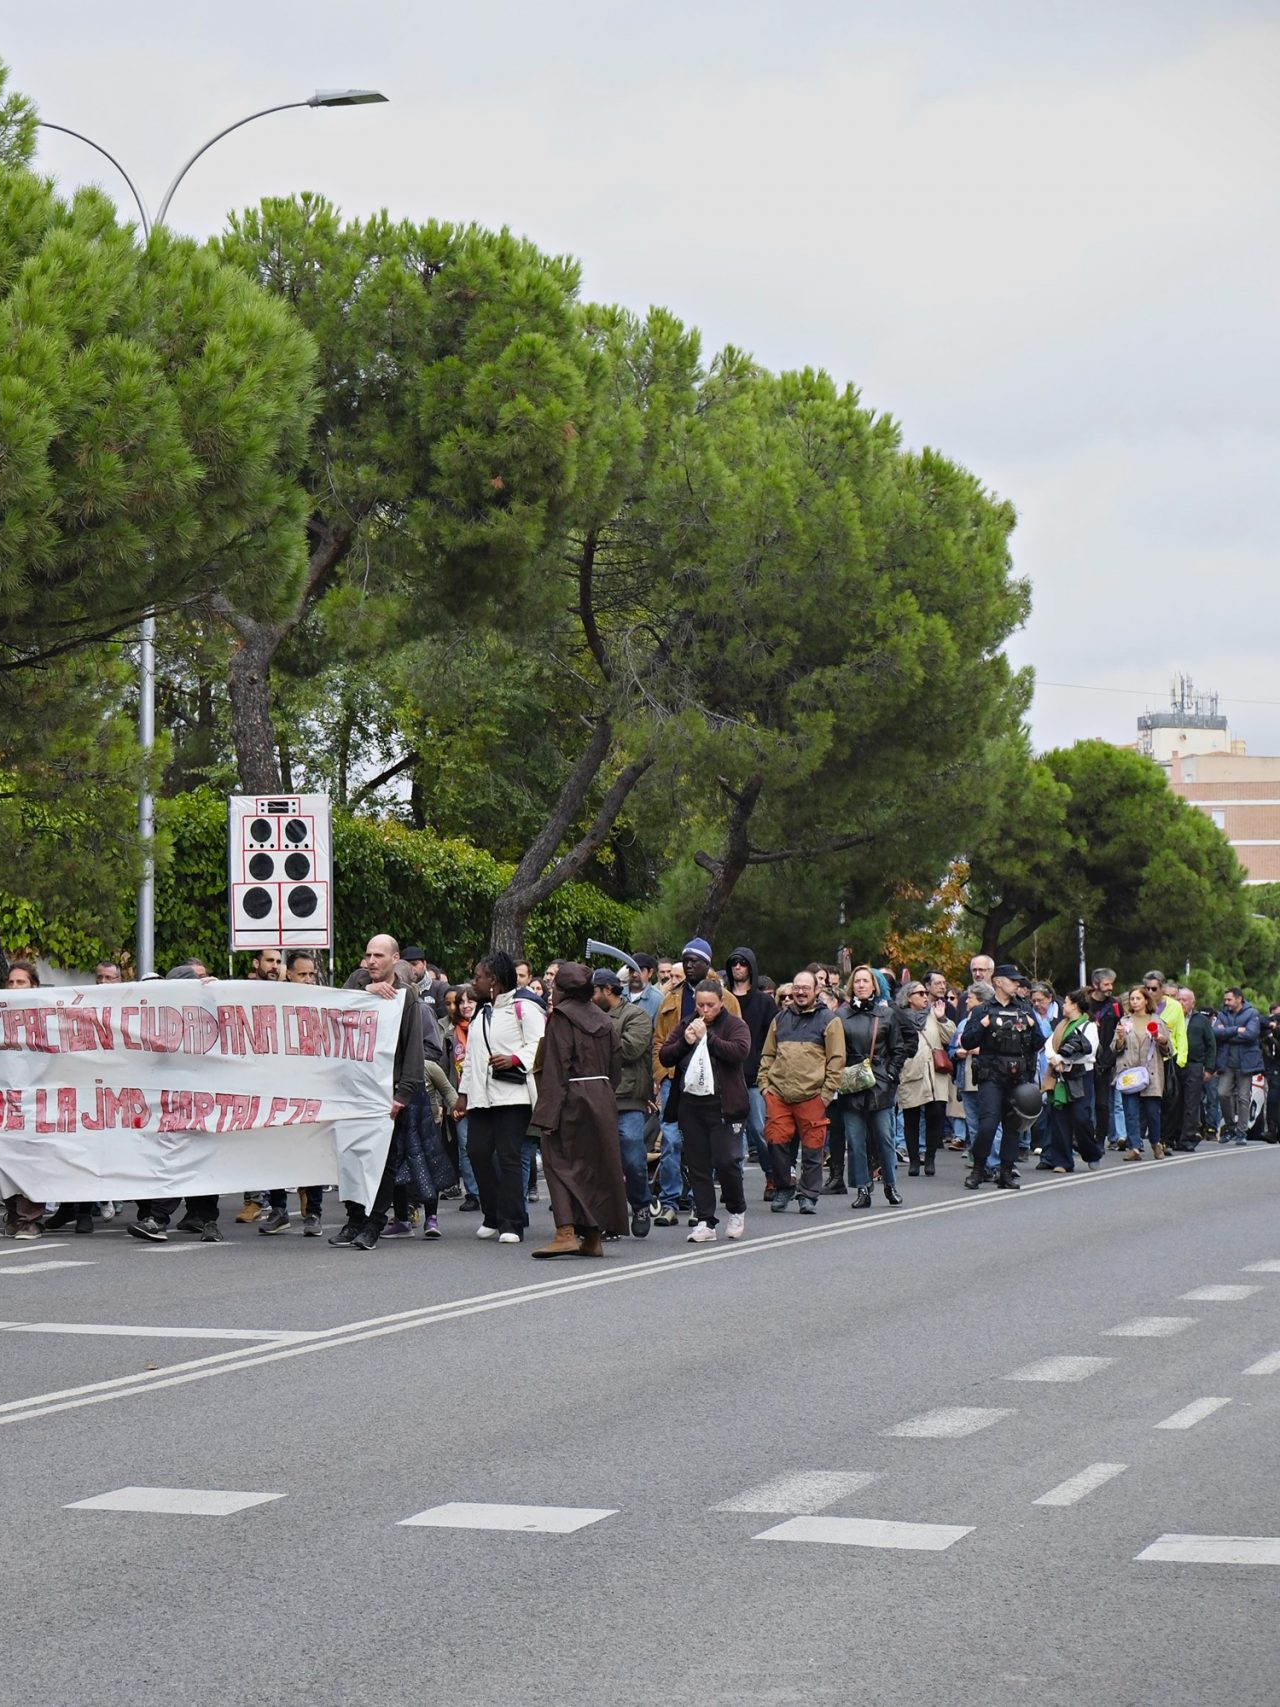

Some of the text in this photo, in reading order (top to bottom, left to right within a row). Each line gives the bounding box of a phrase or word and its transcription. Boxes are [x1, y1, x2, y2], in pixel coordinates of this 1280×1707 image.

[120, 999, 278, 1055] CIUDADANA
[282, 1005, 379, 1062] CONTRA
[36, 1087, 77, 1133] LA
[81, 1079, 152, 1130] JMD
